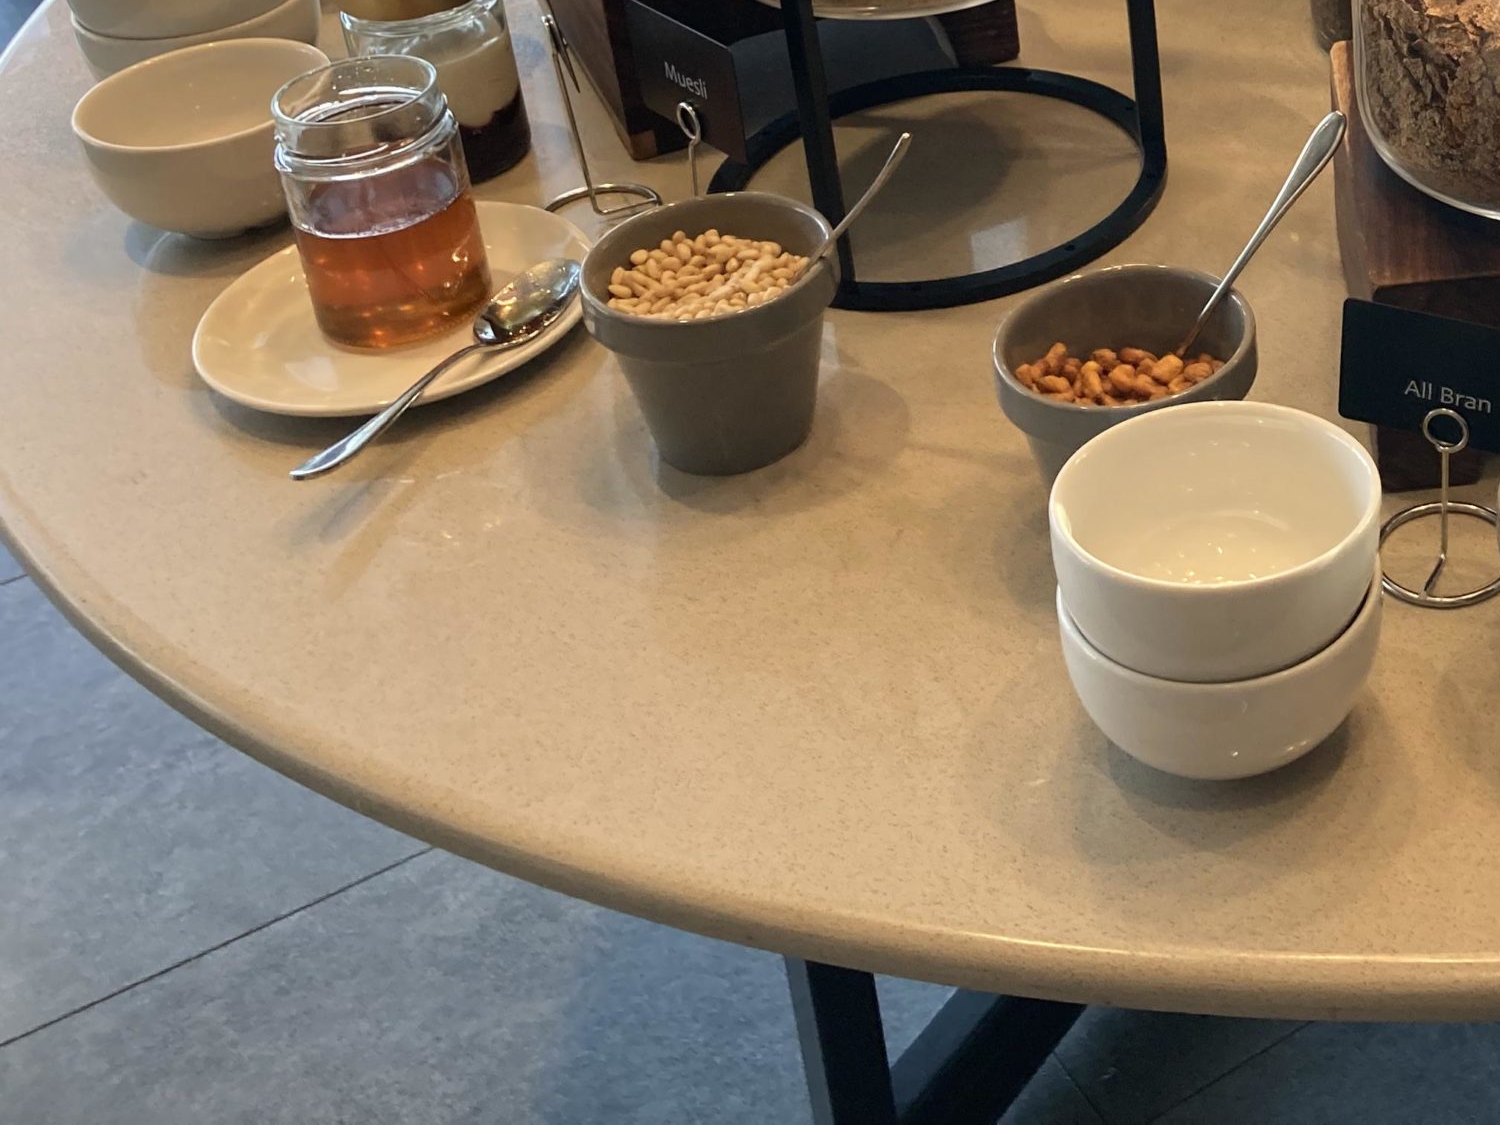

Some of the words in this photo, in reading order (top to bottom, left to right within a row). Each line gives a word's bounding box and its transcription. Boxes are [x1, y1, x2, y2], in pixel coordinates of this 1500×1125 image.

[664, 61, 708, 100] Muesli
[1404, 380, 1433, 401] All
[1440, 386, 1492, 414] Bran
